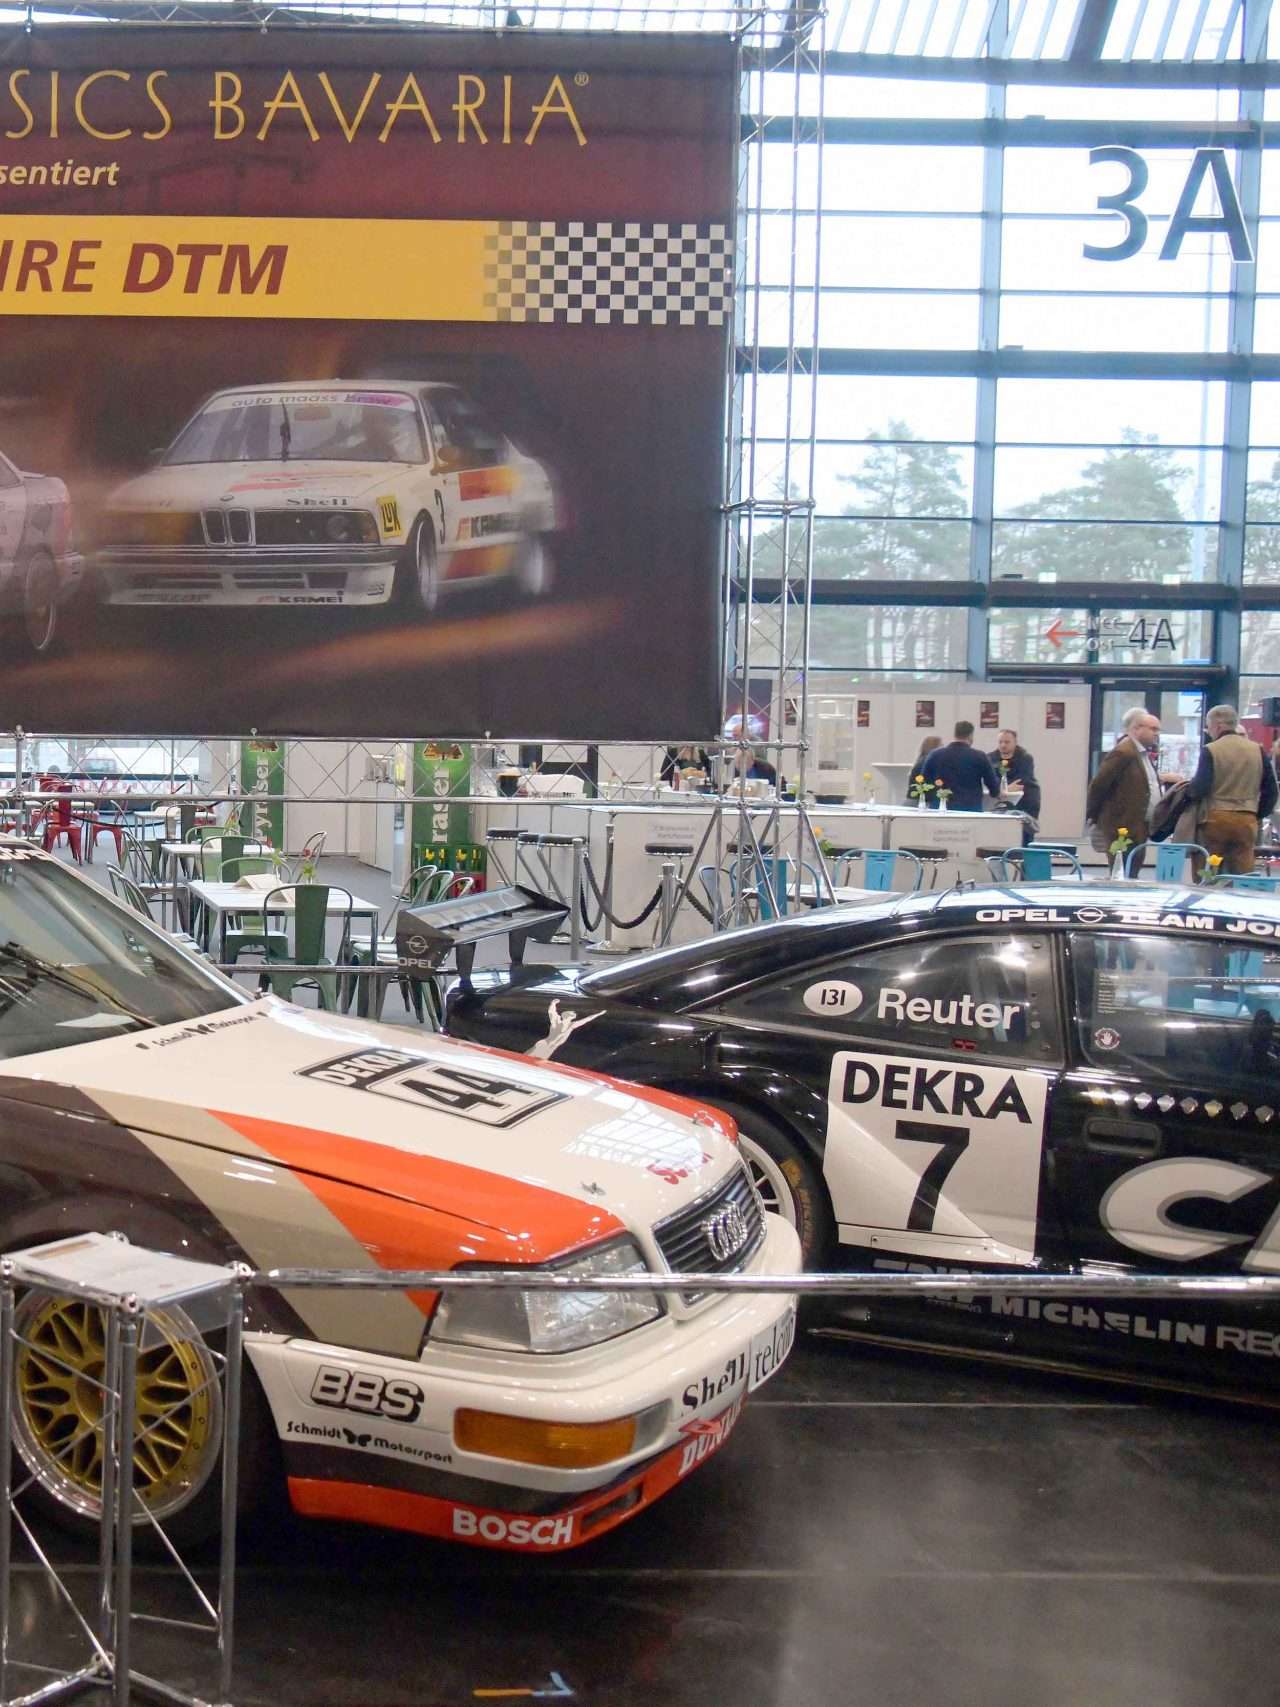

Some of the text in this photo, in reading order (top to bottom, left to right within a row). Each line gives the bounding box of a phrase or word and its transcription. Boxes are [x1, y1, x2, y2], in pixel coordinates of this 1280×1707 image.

[1082, 145, 1255, 264] 3A
[122, 243, 289, 296] DTM
[1129, 617, 1177, 651] 4A
[975, 908, 1070, 924] OPEL
[1112, 910, 1215, 931] TEAM
[876, 986, 1021, 1031] Reuter
[308, 1049, 422, 1087] DEKRA
[400, 1066, 540, 1112] 44
[841, 1060, 1033, 1125] DEKRA
[894, 1119, 971, 1232] 7
[1099, 1156, 1280, 1275] C
[990, 1295, 1207, 1347] MICHELIN
[310, 1363, 425, 1423] BBS
[682, 1351, 746, 1410] Shell
[286, 1420, 454, 1465] Schmidt Motorsport
[452, 1507, 574, 1545] BOSCH
